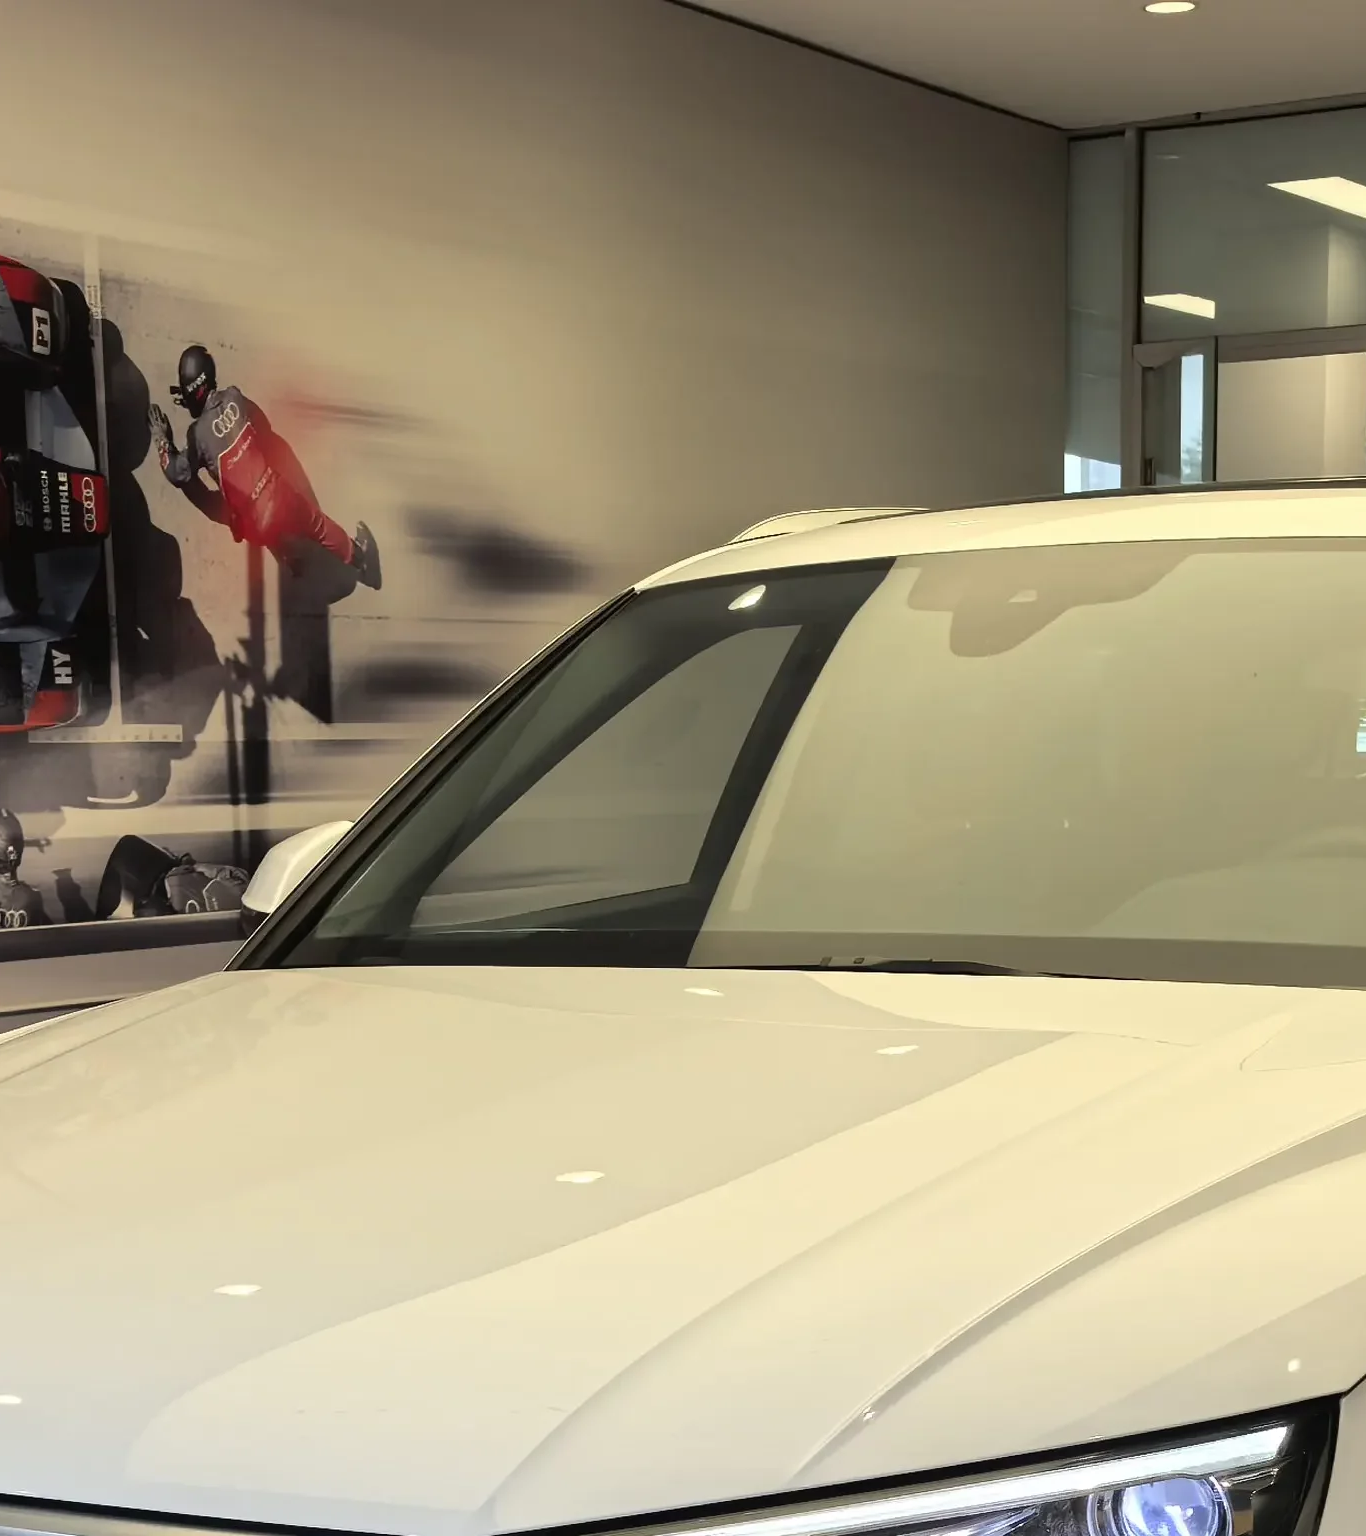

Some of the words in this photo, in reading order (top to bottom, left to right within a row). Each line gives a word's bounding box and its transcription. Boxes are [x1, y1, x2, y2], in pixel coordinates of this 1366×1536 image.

[36, 316, 49, 348] P1
[40, 470, 50, 513] BOSCH
[57, 472, 71, 533] MAHLE
[51, 649, 73, 684] HY
